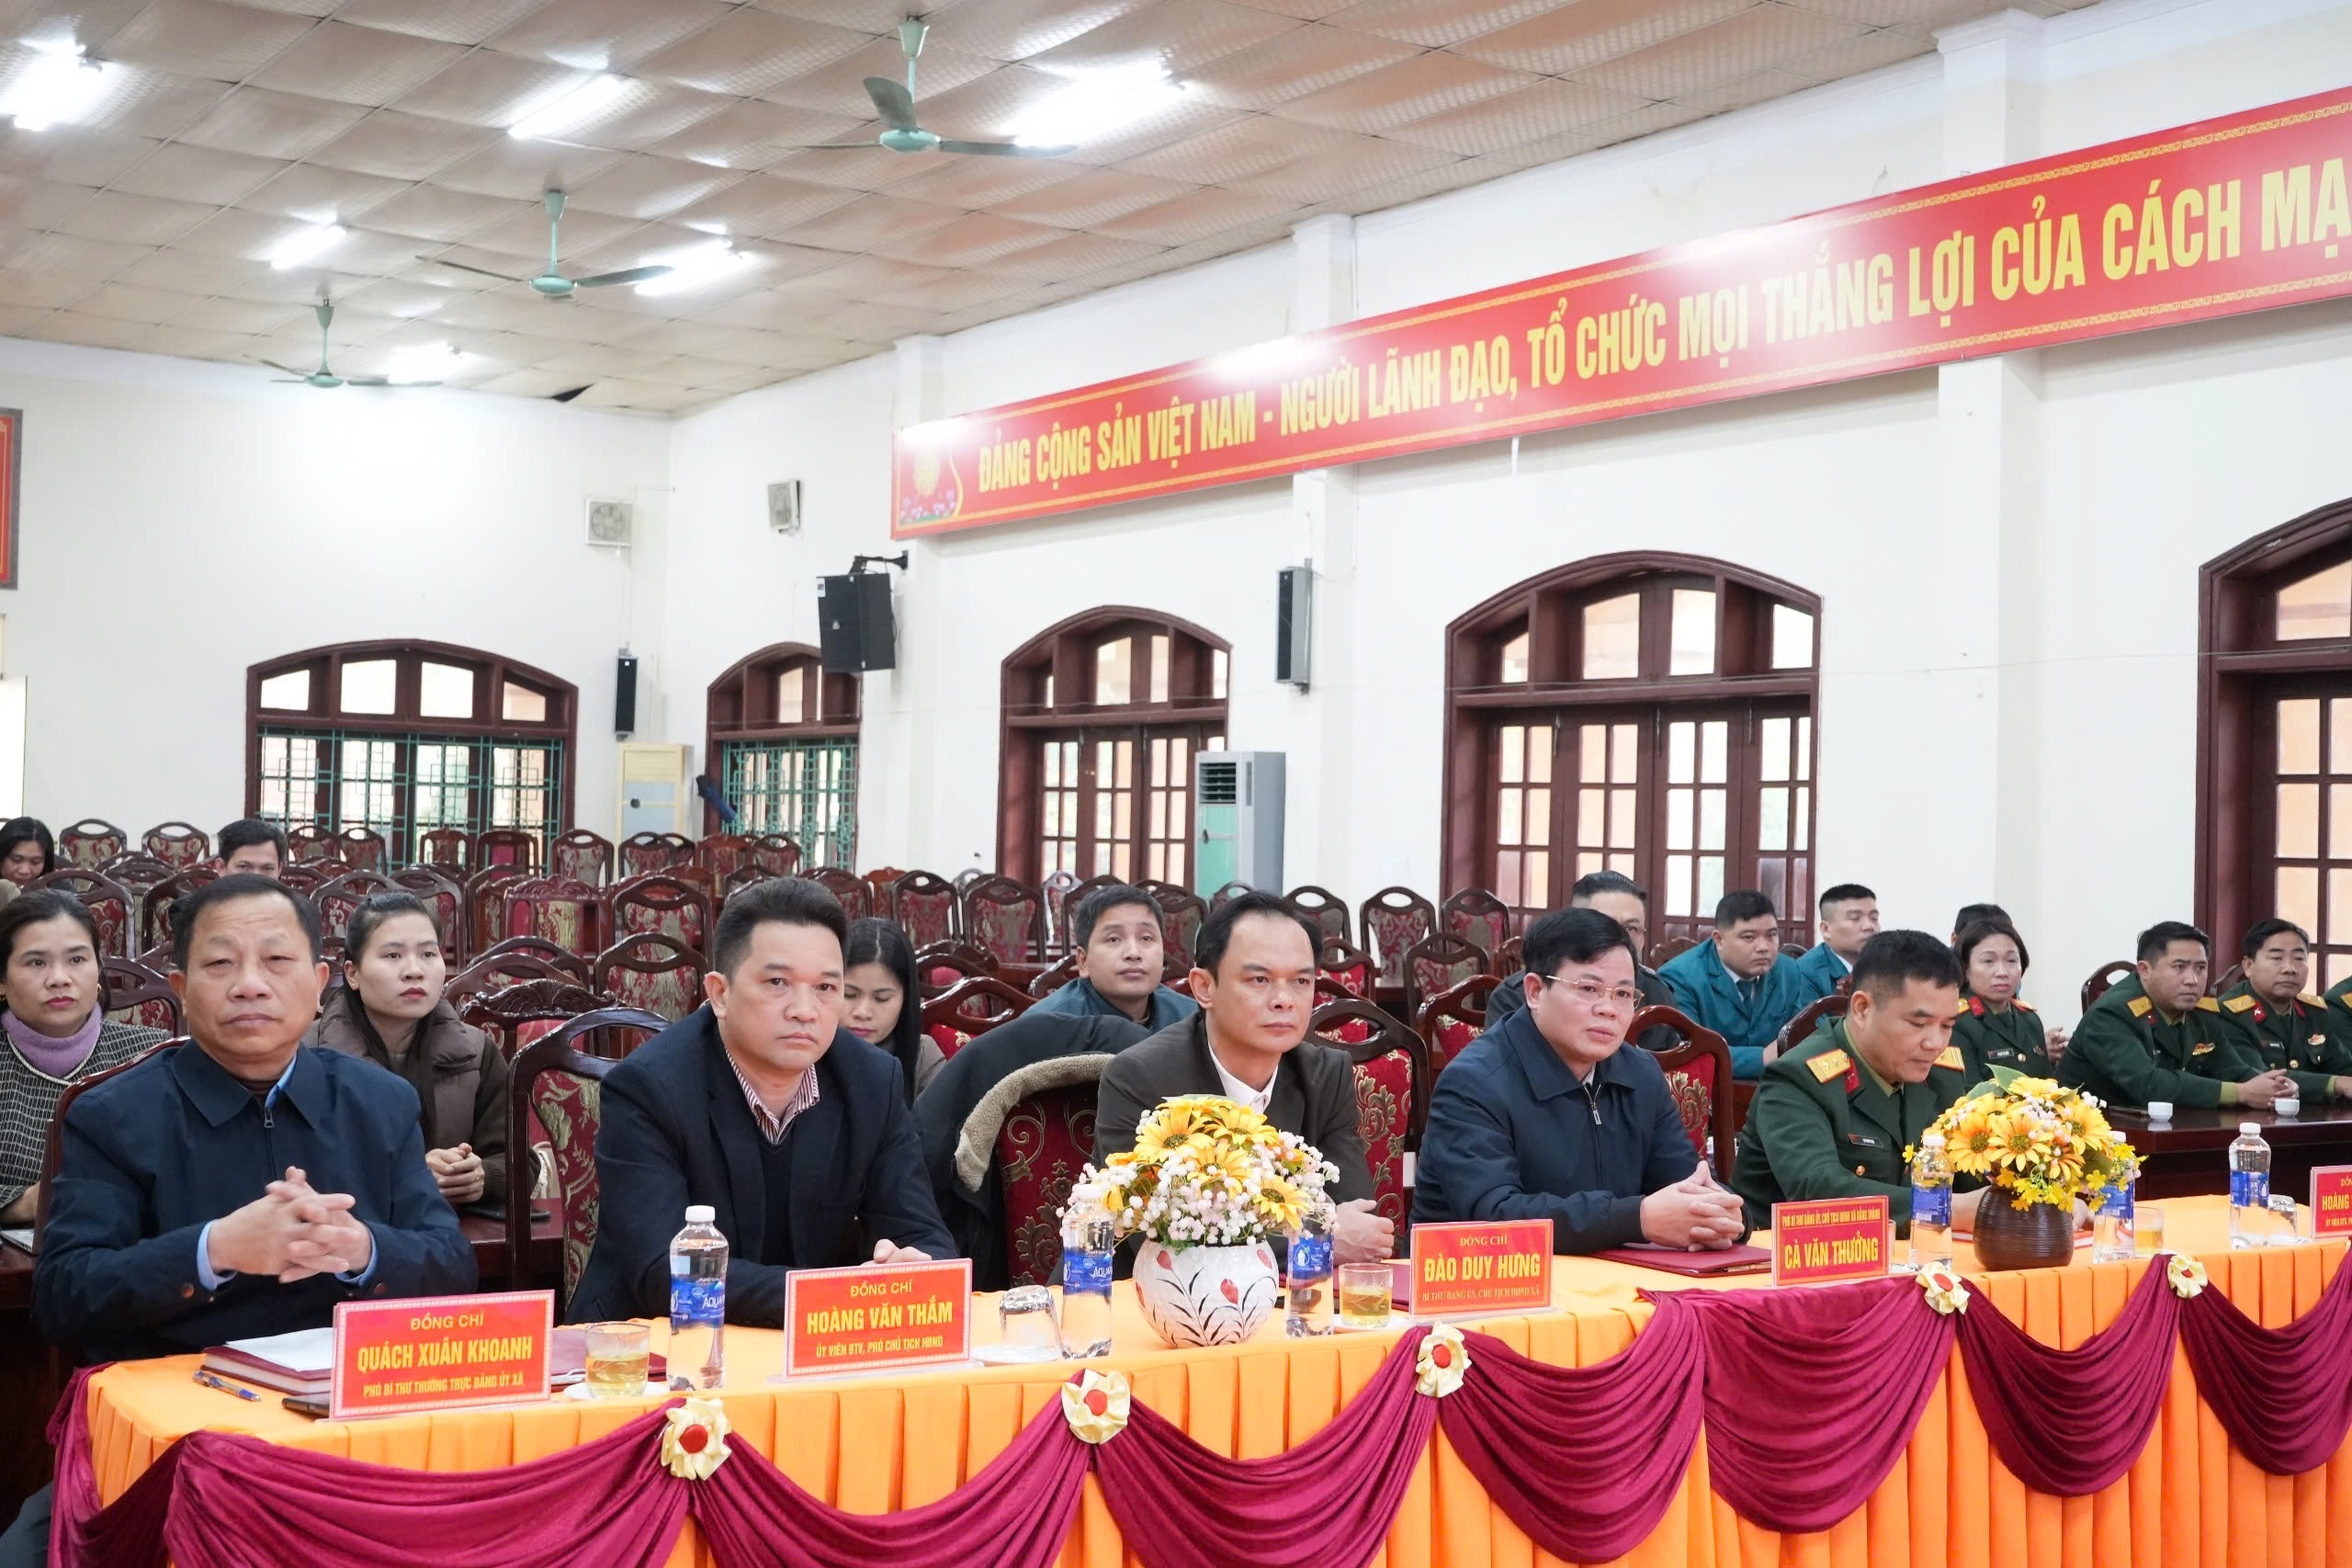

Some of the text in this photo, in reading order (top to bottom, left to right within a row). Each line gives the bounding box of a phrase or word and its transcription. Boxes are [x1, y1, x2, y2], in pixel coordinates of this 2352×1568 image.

[978, 429, 1031, 492] ĐẢNG
[1036, 421, 1091, 490] CỘNG
[1097, 402, 1141, 470] SẢN
[1148, 396, 1193, 468] VIỆT
[1201, 390, 1256, 450] NAM
[1281, 355, 1359, 435] NGƯỜI
[1368, 347, 1441, 419] LÃNH
[1449, 334, 1518, 412] ĐẠO,
[1527, 298, 1567, 388] TỔ
[1577, 293, 1666, 379] CHỨC
[1678, 288, 1747, 367] MỌI
[1761, 241, 1894, 345] THẮNG
[1908, 230, 1975, 328] LỢI
[1991, 195, 2086, 296] CỦA
[2102, 179, 2241, 280] CÁCH
[1804, 1237, 1829, 1268] VĂN
[1831, 1230, 1879, 1265] THƯỞNG
[1424, 1252, 1457, 1283] ĐÀO
[1462, 1255, 1494, 1280] DUY
[850, 1279, 912, 1297] ĐỒNG CHÍ
[411, 1310, 484, 1331] ĐỒNG CHÍ
[807, 1294, 953, 1335] HOÀNG VĂN THẮM
[357, 1336, 532, 1374] QUÁCH XUÂN KHOANH
[363, 1382, 381, 1397] PHÓ
[383, 1382, 392, 1396] BÍ
[395, 1381, 413, 1395] THƯ
[413, 1376, 447, 1393] THƯỜNG
[449, 1376, 471, 1393] TRỰC
[473, 1372, 497, 1390] ĐẢNG
[499, 1371, 510, 1387] ỦY
